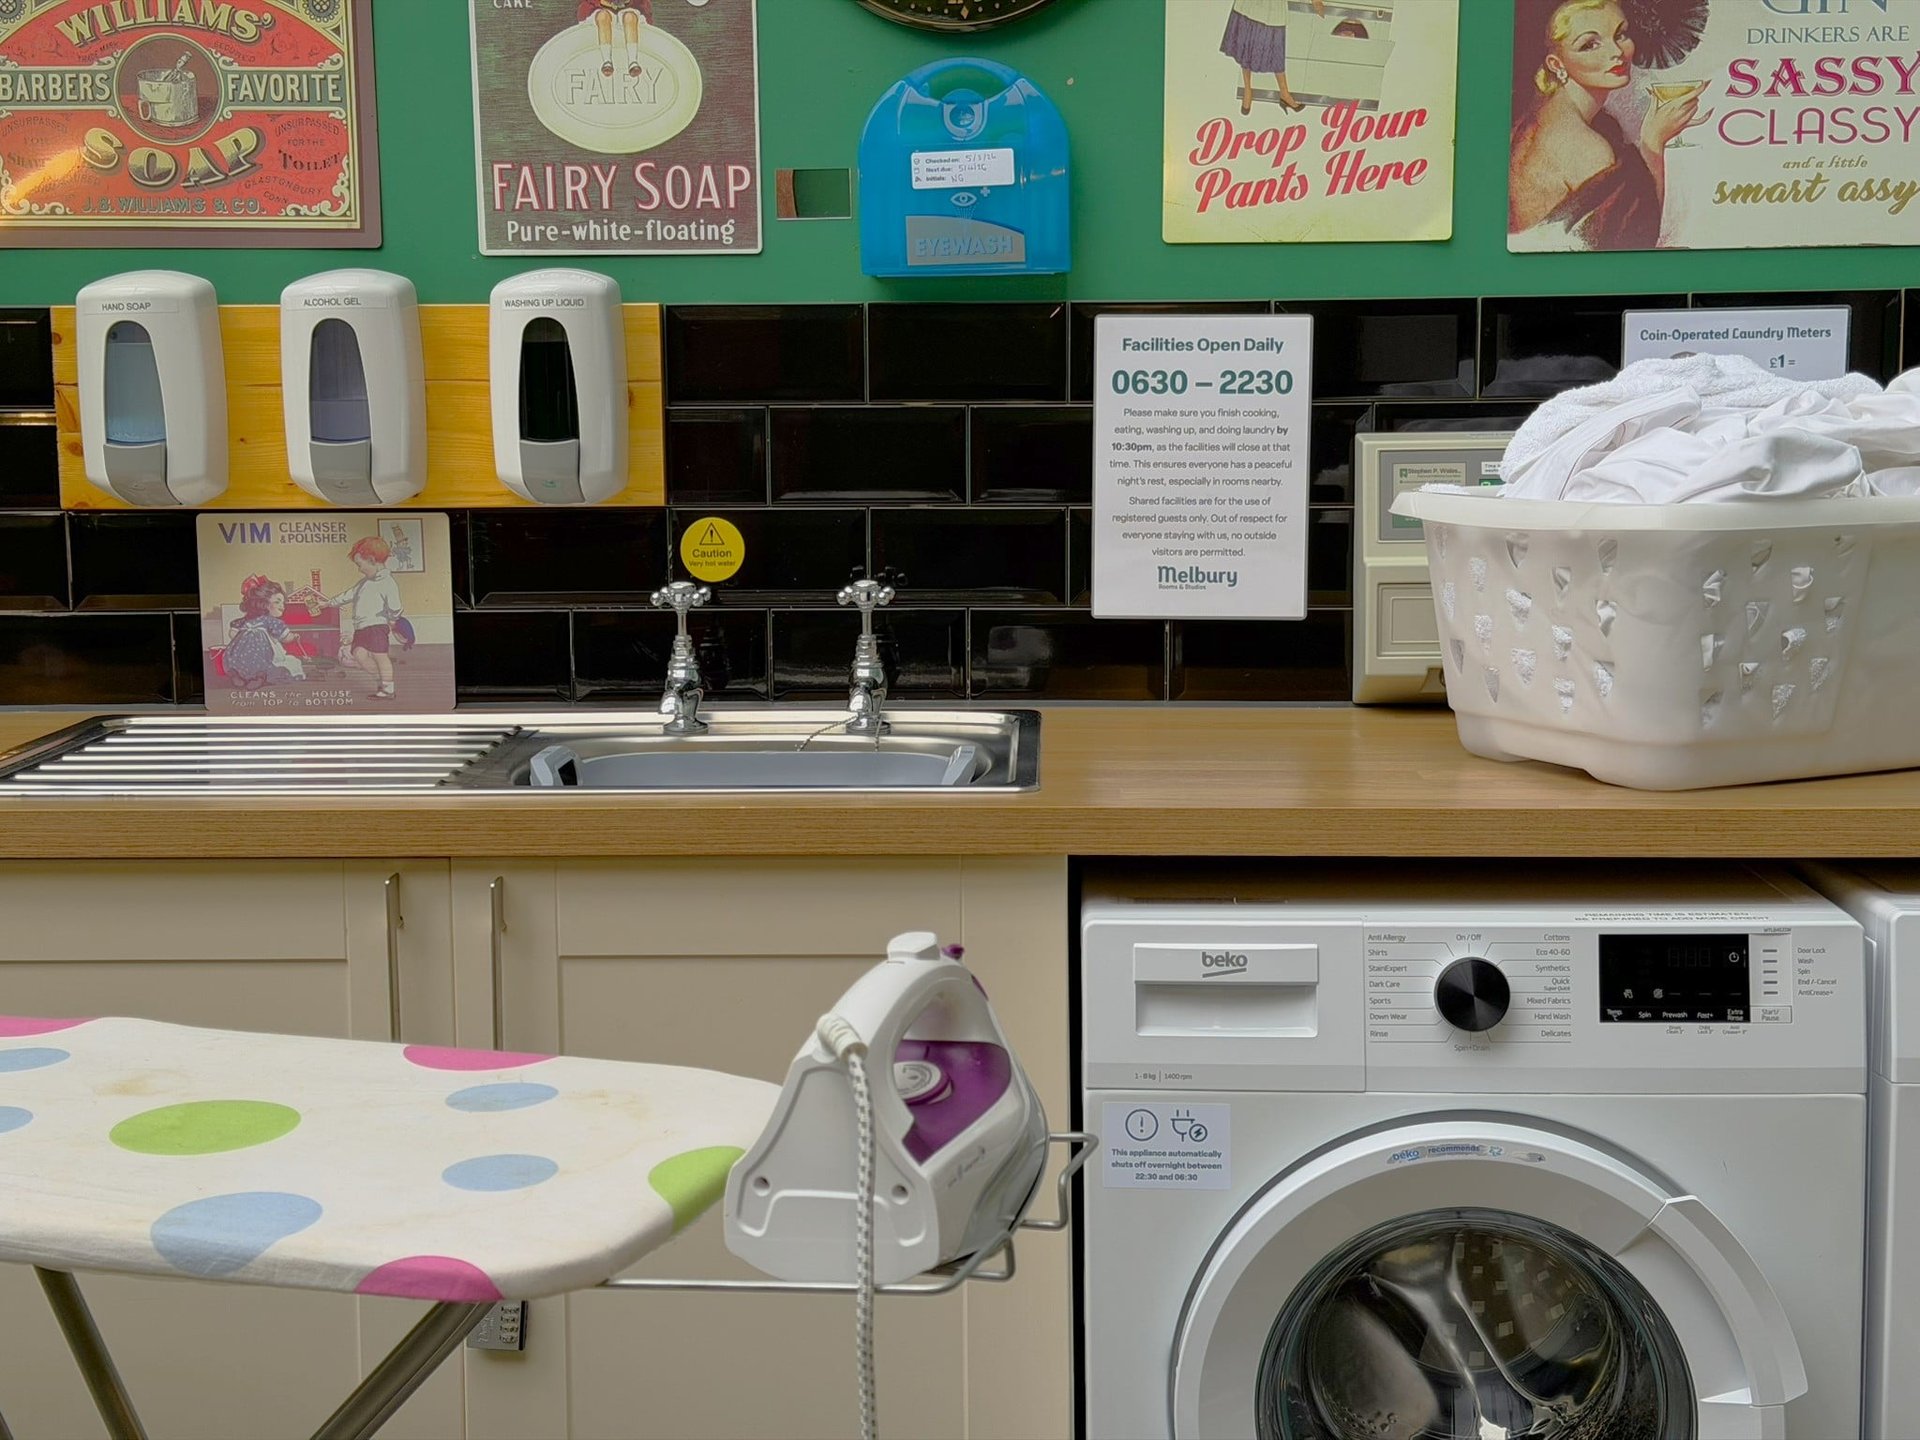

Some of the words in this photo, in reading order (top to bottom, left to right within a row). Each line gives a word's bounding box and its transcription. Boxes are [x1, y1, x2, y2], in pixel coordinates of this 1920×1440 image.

[56, 0, 275, 48] WILLIAMS'
[1747, 27, 1860, 44] DRINKERS
[1867, 26, 1909, 42] ARE
[1725, 50, 1920, 98] SASSY
[0, 73, 112, 102] BARBERS
[228, 74, 341, 102] FAVORITE
[564, 67, 664, 104] FAIRY
[275, 118, 340, 136] UNSURPASSED
[1718, 106, 1920, 146] CLASSY
[1189, 117, 1307, 169] Drop
[1321, 99, 1429, 152] Your
[83, 127, 262, 188] SOAP
[279, 150, 340, 170] TOILET
[1782, 156, 1815, 169] and
[1815, 160, 1825, 169] a
[1828, 154, 1868, 169] little
[245, 176, 321, 195] GLASTONBURY
[493, 163, 617, 210] FAIRY
[634, 162, 751, 210] SOAP
[1194, 162, 1308, 214] Pants
[1325, 149, 1428, 197] Here
[1712, 172, 1830, 205] smart
[1837, 177, 1920, 215] assy
[119, 196, 205, 214] WILLIAMS
[507, 220, 736, 244] Pure-white-floating
[916, 236, 1013, 257] EYEWASH
[102, 303, 124, 311] HAND
[127, 302, 151, 310] SOAP
[304, 298, 341, 306] ALCOHOL
[344, 297, 361, 305] GEL
[504, 299, 540, 307] WASHING
[556, 299, 584, 307] LIQUID
[1640, 329, 1729, 342] Coin-Operated
[1732, 328, 1783, 340] Laundry
[1786, 327, 1831, 339] Meters
[1122, 338, 1194, 351] Facilities
[1197, 338, 1240, 354] Open
[1244, 337, 1284, 354] Daily
[1769, 354, 1785, 368] £1
[1112, 370, 1188, 394] 0630
[1219, 370, 1293, 394] 2230
[1123, 408, 1152, 417] Please
[1154, 408, 1178, 417] make
[1200, 410, 1216, 420] you
[1218, 408, 1240, 417] finish
[1242, 408, 1280, 419] cooking,
[1114, 426, 1144, 436] eating,
[1146, 426, 1182, 436] washing
[1183, 427, 1197, 436] up,
[1199, 426, 1215, 434] and
[1217, 426, 1241, 436] doing
[1242, 426, 1275, 436] laundry
[1277, 426, 1288, 436] by
[1111, 443, 1154, 452] 10:30pm,
[1168, 443, 1183, 451] the
[1184, 443, 1220, 451] facilities
[1222, 443, 1235, 451] will
[1237, 443, 1260, 451] close
[1272, 443, 1290, 451] that
[1110, 460, 1130, 468] time.
[1134, 460, 1151, 468] This
[1188, 462, 1228, 470] everyone
[1230, 460, 1246, 468] has
[1254, 460, 1292, 470] peaceful
[1117, 477, 1146, 486] night's
[1147, 477, 1167, 486] rest,
[1169, 477, 1211, 486] especially
[1212, 477, 1220, 485] in
[1251, 477, 1283, 486] nearby.
[1129, 497, 1160, 505] Shared
[1162, 497, 1197, 505] facilities
[1214, 497, 1227, 505] for
[1228, 497, 1243, 505] the
[1261, 497, 1271, 505] of
[1112, 514, 1156, 524] registered
[1158, 515, 1187, 524] guests
[1189, 514, 1209, 524] only.
[1210, 514, 1227, 523] Out
[1229, 514, 1238, 523] of
[1239, 515, 1273, 524] respect
[1275, 514, 1288, 523] for
[218, 522, 271, 544] VIM
[279, 522, 346, 533] CLEANSER
[280, 535, 286, 543] &
[288, 533, 347, 543] POLISHER
[1122, 533, 1162, 541] everyone
[1164, 532, 1195, 541] staying
[1197, 531, 1215, 539] with
[1217, 533, 1229, 541] us,
[1244, 531, 1277, 539] outside
[692, 549, 732, 558] Caution
[1152, 548, 1183, 556] visitors
[1200, 548, 1245, 558] permitted.
[1158, 566, 1237, 587] Melbury
[230, 691, 276, 699] CLEANS
[311, 690, 351, 698] HOUSE
[1386, 934, 1406, 942] Allergy
[1201, 951, 1248, 967] beko
[1368, 965, 1407, 973] StainExpert
[1535, 965, 1571, 973] Synthetics
[1551, 977, 1570, 985] Quick
[1369, 997, 1391, 1006] Sports
[1638, 1011, 1651, 1019] Spin
[1370, 1030, 1388, 1038] Rinse
[1541, 1030, 1571, 1038] Delicates
[1129, 1149, 1166, 1158] appliance
[1168, 1150, 1222, 1158] automatically
[1147, 1162, 1186, 1170] overnight
